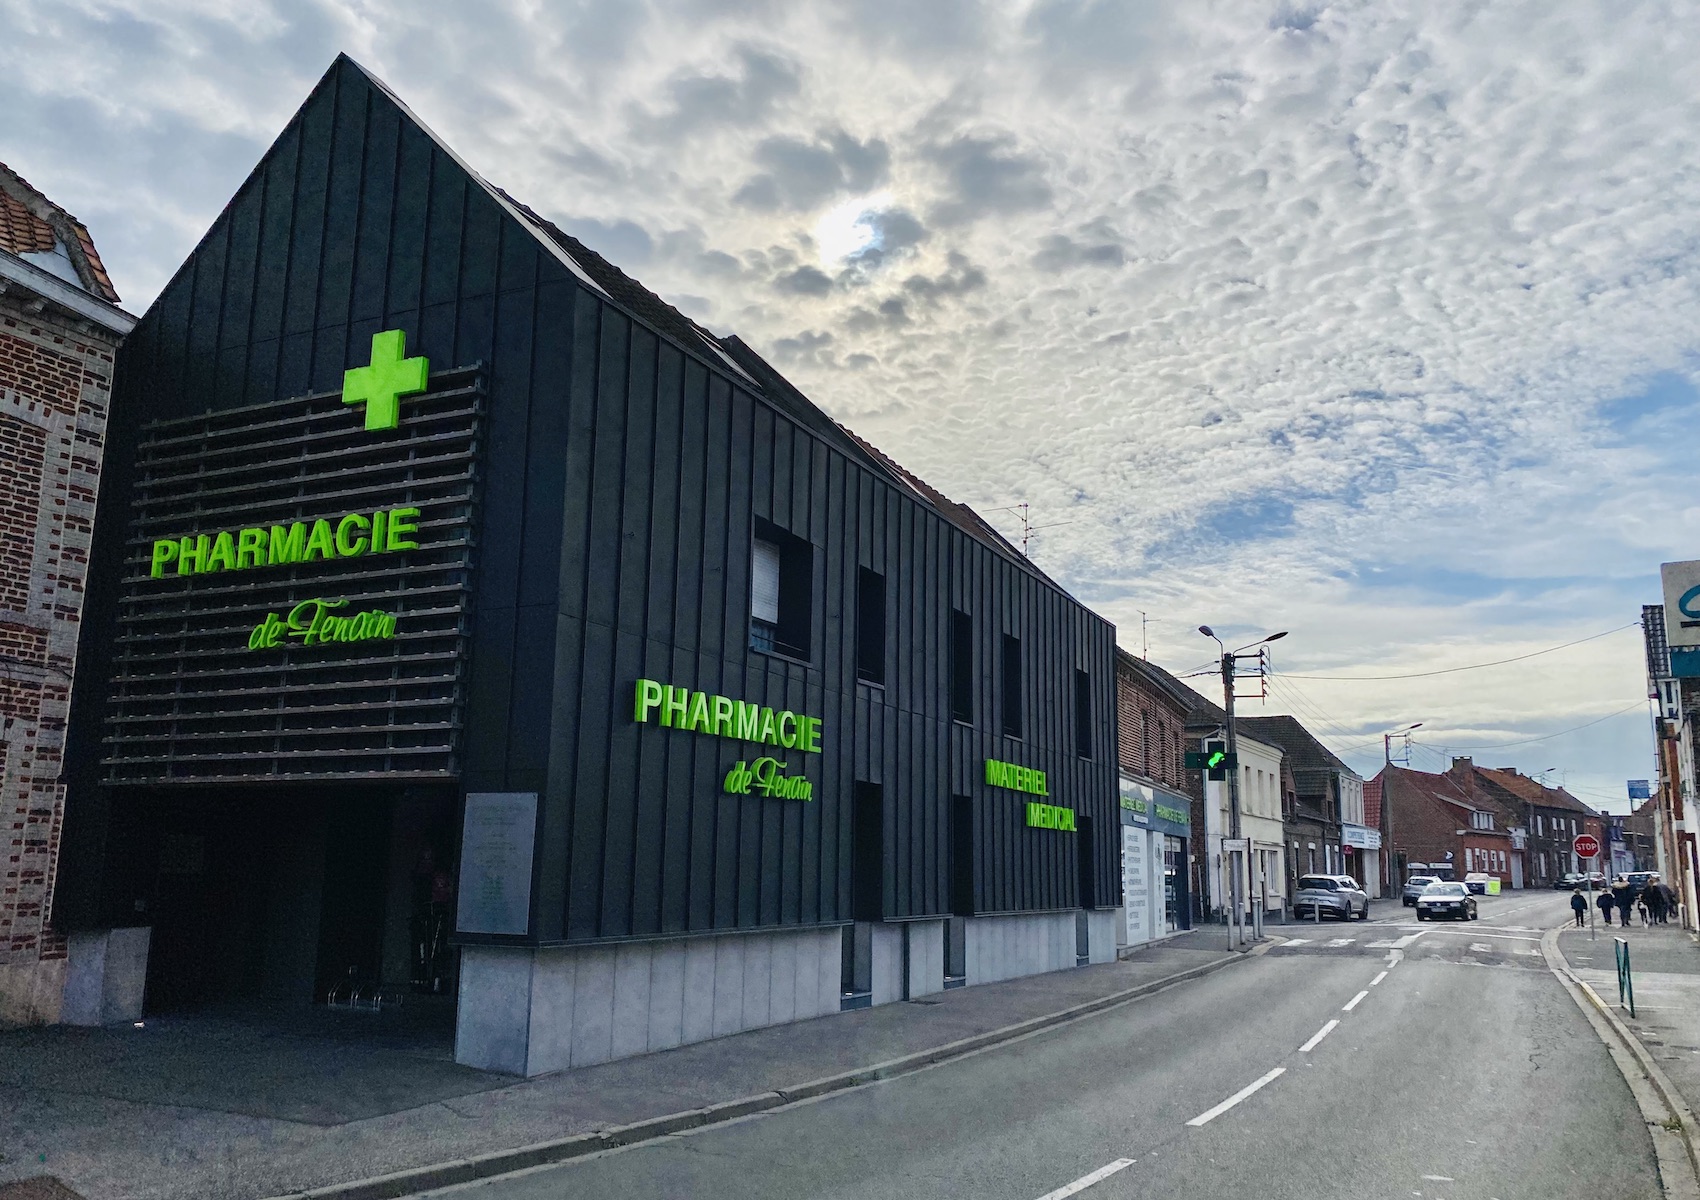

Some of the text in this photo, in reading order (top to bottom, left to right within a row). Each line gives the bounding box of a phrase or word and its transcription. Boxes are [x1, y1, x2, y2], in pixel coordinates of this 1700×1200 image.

[151, 507, 421, 579] PHARMACIE
[248, 598, 397, 650] de Fenain
[634, 679, 822, 754] PHARMACIE
[724, 757, 813, 801] de Fenain
[985, 759, 1049, 797] MATERIEL
[1026, 801, 1077, 833] MEDICAL
[1575, 842, 1597, 851] STOP
